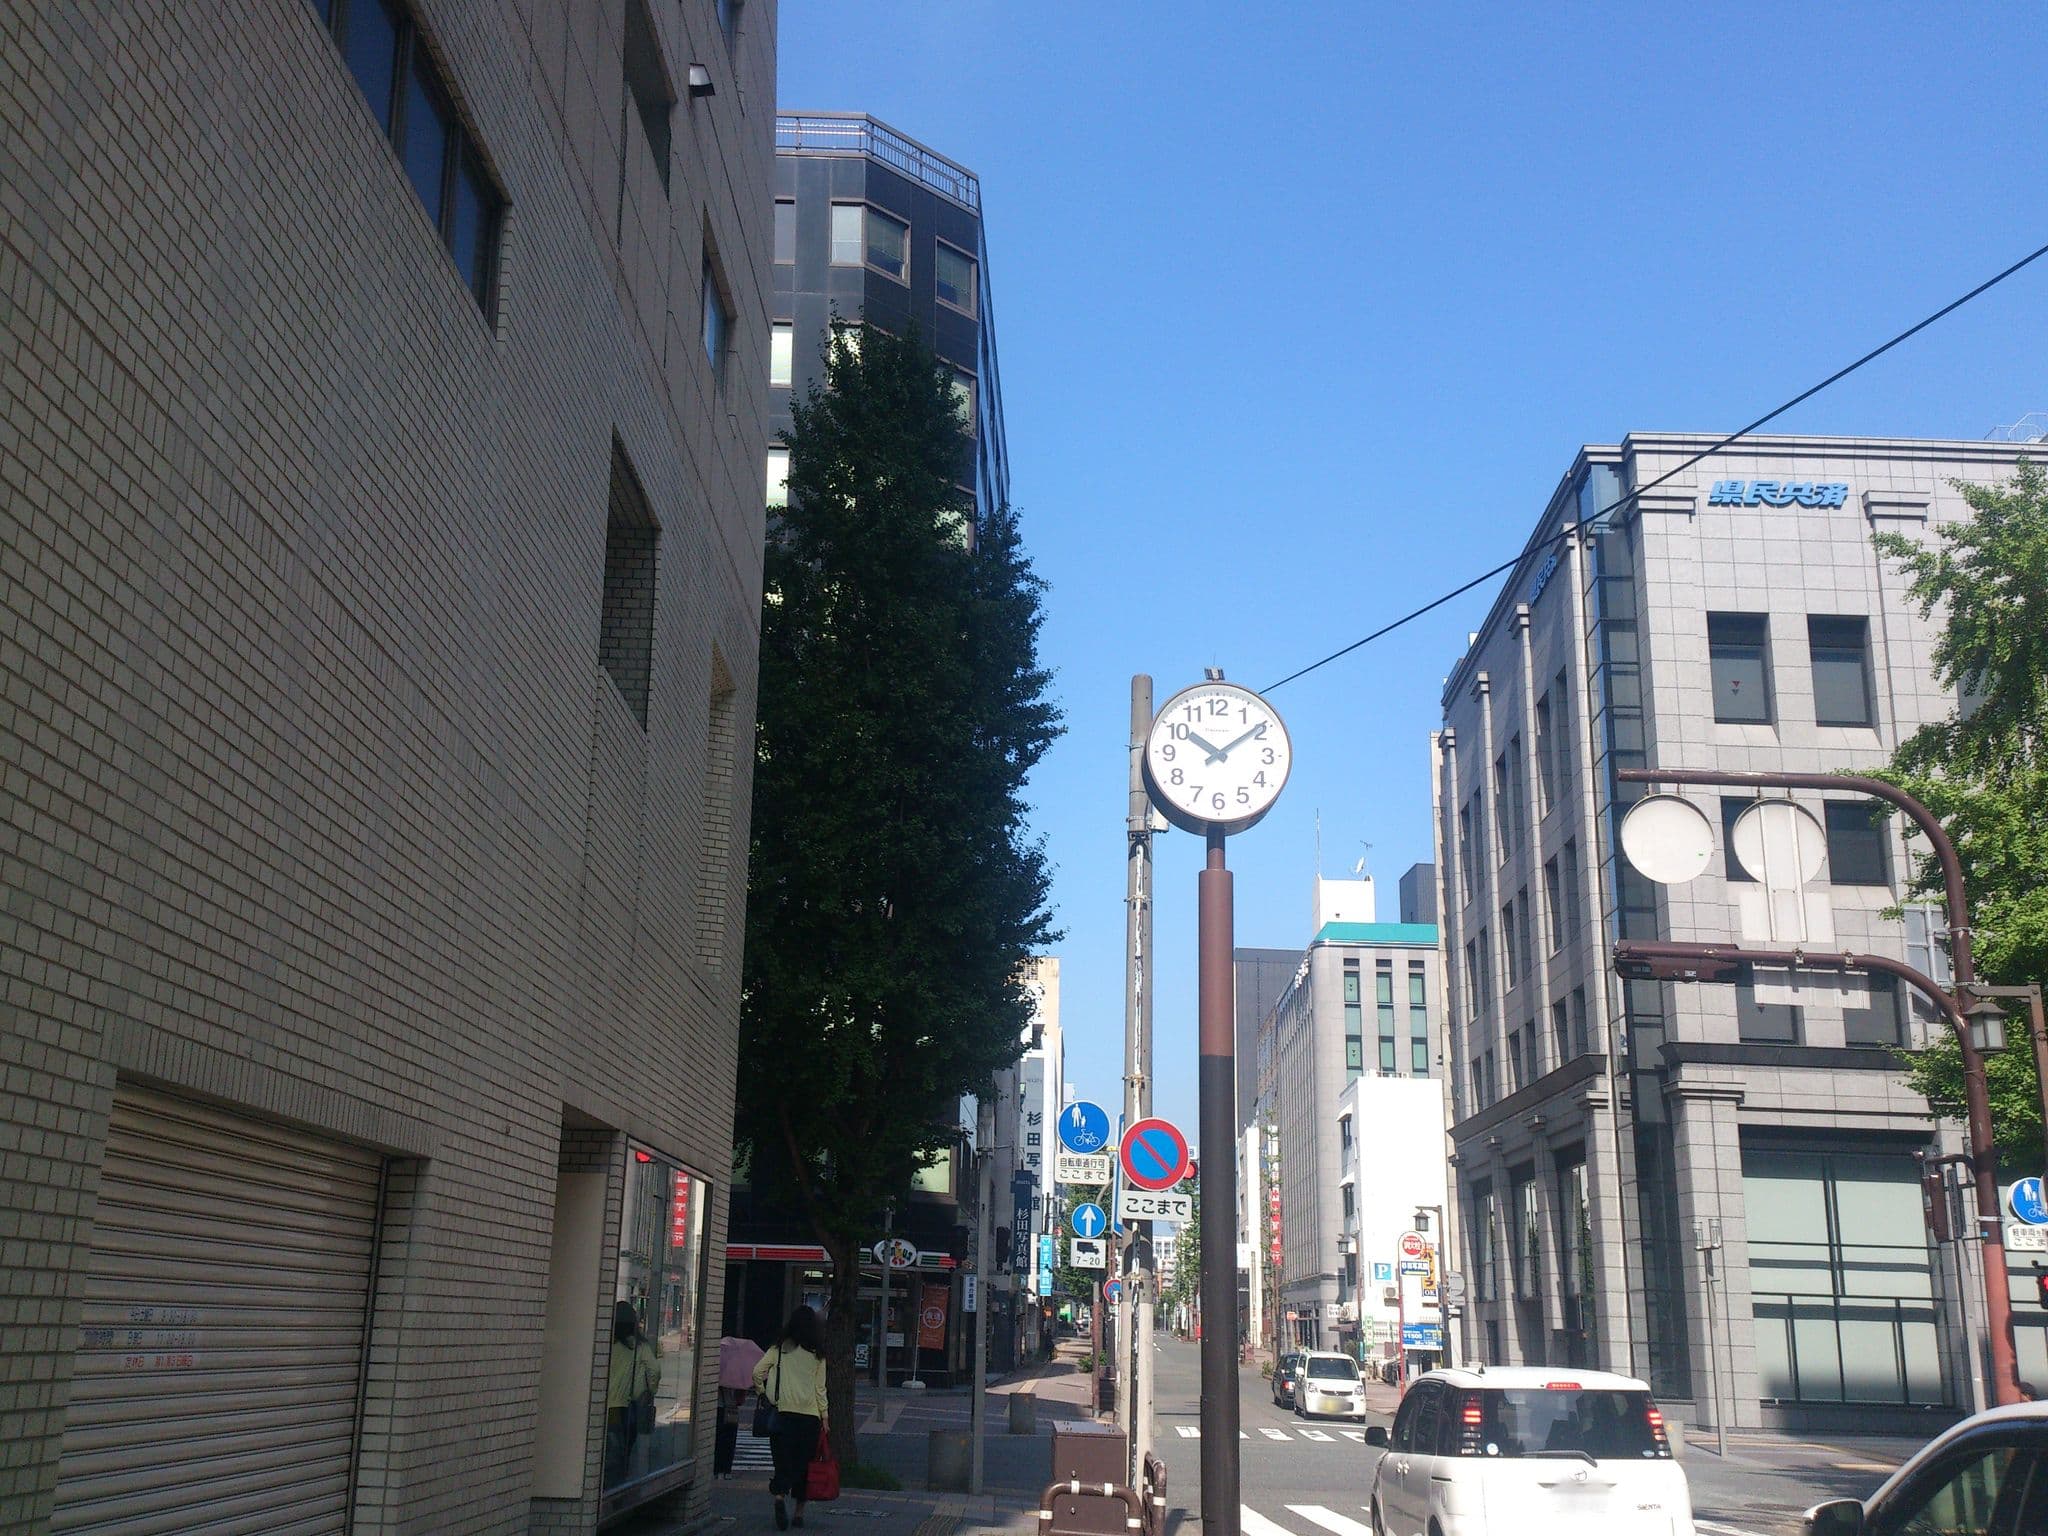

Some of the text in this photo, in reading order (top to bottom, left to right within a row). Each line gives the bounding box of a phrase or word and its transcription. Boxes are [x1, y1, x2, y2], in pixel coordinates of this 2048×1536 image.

[1708, 479, 1849, 509] 県民共済
[1183, 705, 1202, 723] 11
[1206, 699, 1229, 716] 12
[1238, 707, 1247, 724] 1
[1167, 723, 1189, 741] 10
[1254, 723, 1267, 741] 2
[1162, 745, 1176, 762] 9
[1261, 747, 1275, 765] 3
[1170, 768, 1184, 785] 8
[1253, 770, 1267, 788] 4
[1190, 786, 1203, 803] 7
[1212, 792, 1225, 810] 6
[1236, 787, 1249, 804] 5
[1059, 1157, 1105, 1169] 自転車通行可
[1060, 1169, 1106, 1181] ここまで
[1125, 1197, 1187, 1216] ここまで
[1016, 1208, 1028, 1268] 杉田写真館
[1076, 1257, 1101, 1266] 7-20
[1377, 1265, 1388, 1279] P
